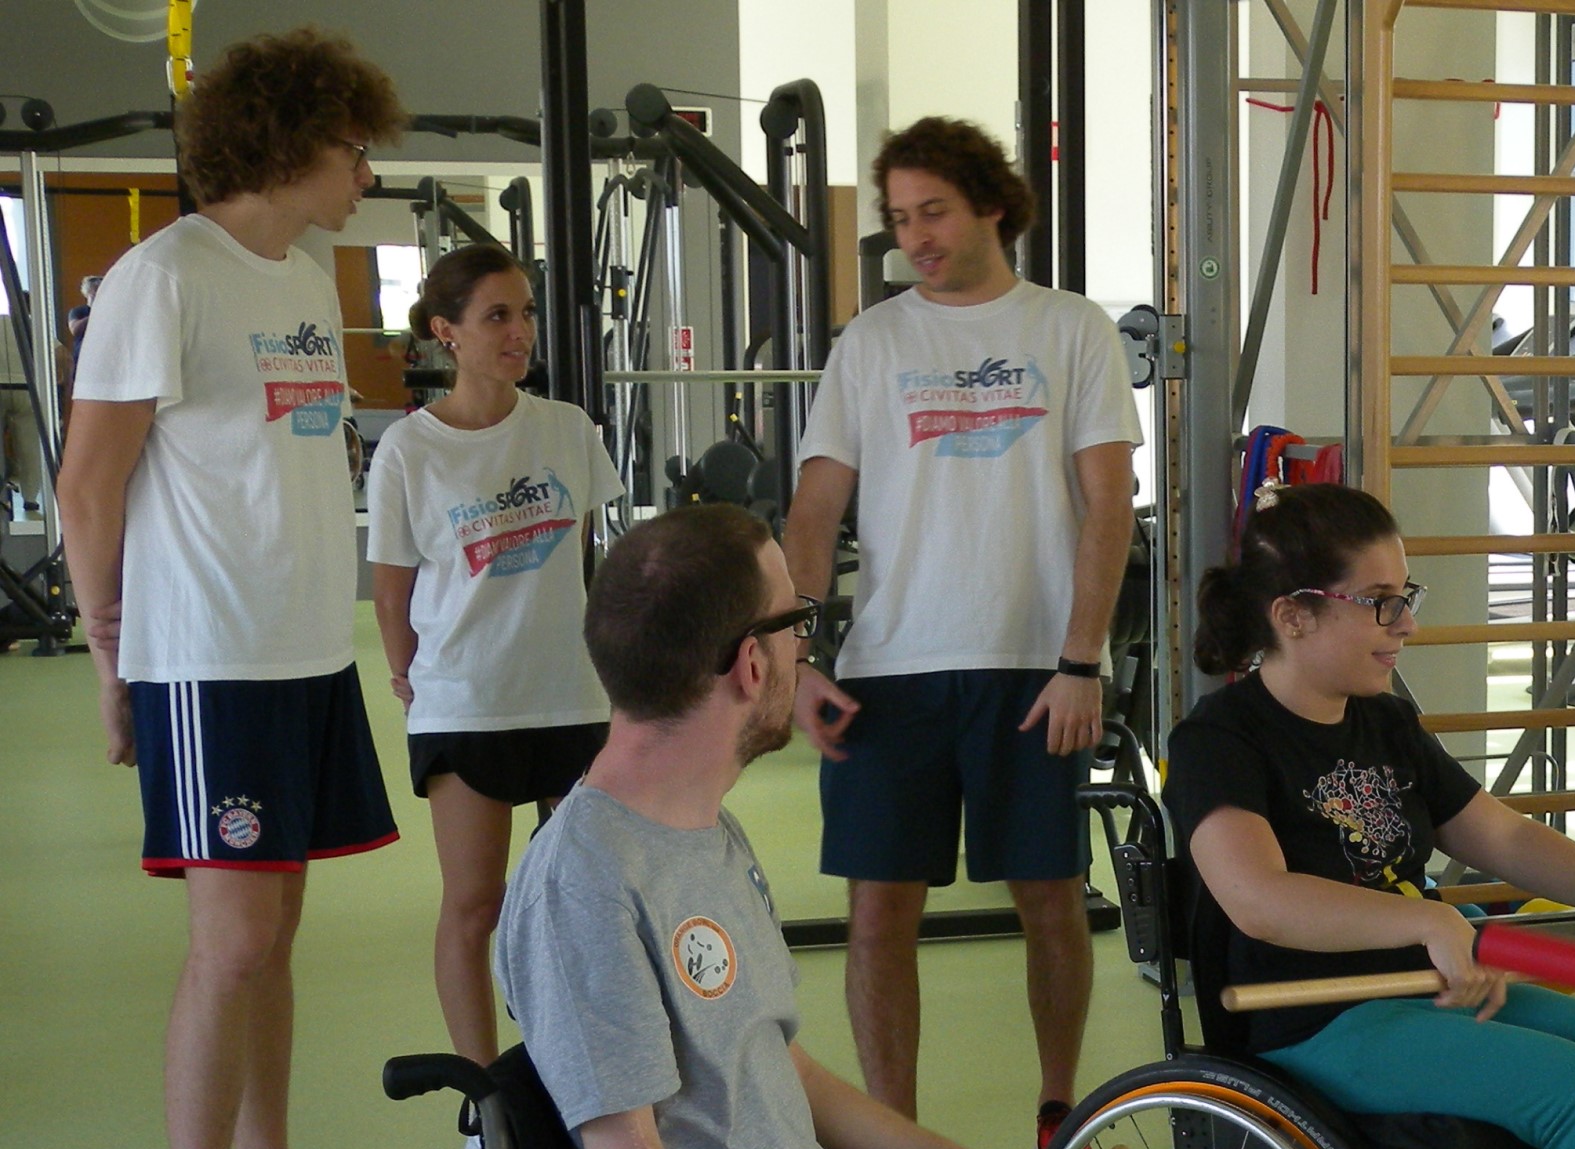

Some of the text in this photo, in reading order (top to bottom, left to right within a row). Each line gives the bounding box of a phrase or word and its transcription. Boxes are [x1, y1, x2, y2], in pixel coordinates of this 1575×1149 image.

[251, 321, 333, 356] FisioSPORT
[272, 357, 337, 373] CIVITAS VITAE
[919, 386, 1022, 404] CIVITAS VITAE
[448, 476, 550, 525] FisioSPORT
[471, 502, 553, 533] CIVITAS VITAE
